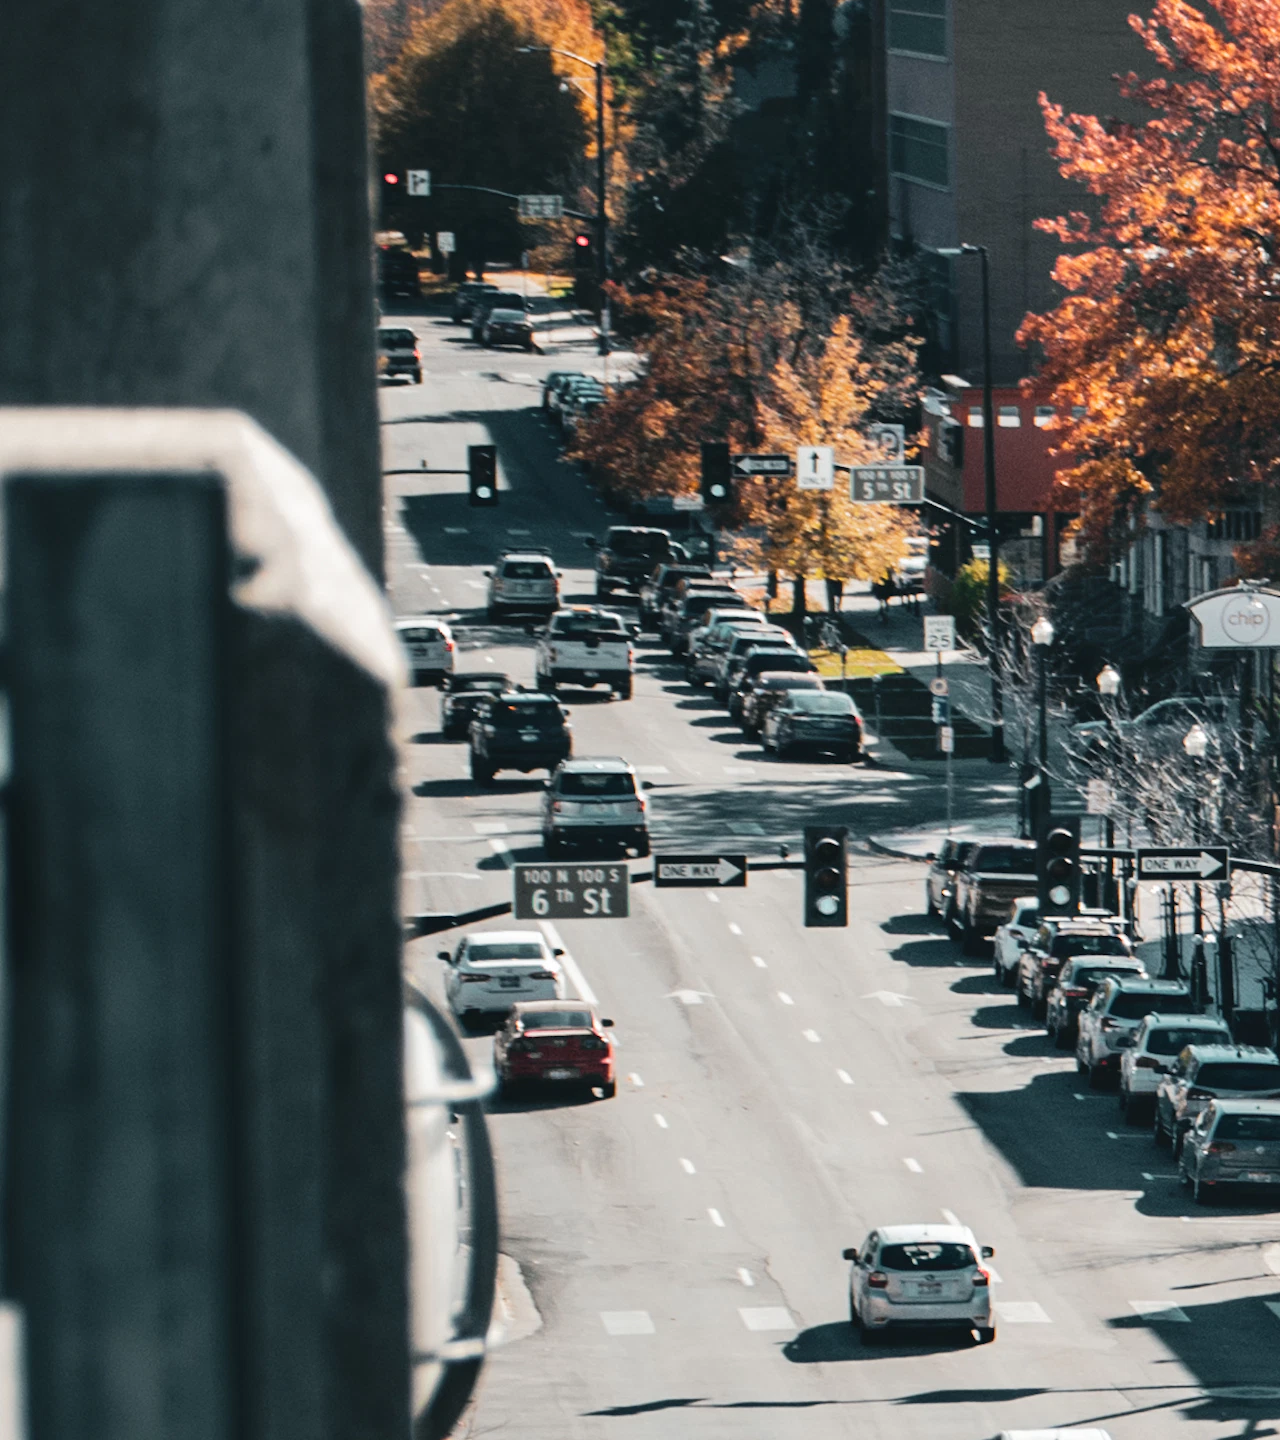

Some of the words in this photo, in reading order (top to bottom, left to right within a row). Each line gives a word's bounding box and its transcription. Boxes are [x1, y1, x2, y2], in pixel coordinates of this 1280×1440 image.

[863, 482, 873, 499] 5
[892, 482, 911, 499] St
[1228, 611, 1264, 628] chip
[929, 635, 951, 648] 25
[662, 865, 687, 878] ONE
[693, 865, 718, 877] WAY
[1145, 859, 1168, 871] ONE
[1174, 858, 1198, 870] WAY
[524, 869, 551, 884] 100
[556, 869, 568, 883] N
[578, 869, 604, 883] 100
[609, 868, 620, 883] S
[532, 889, 549, 916] 6
[583, 888, 612, 915] St
